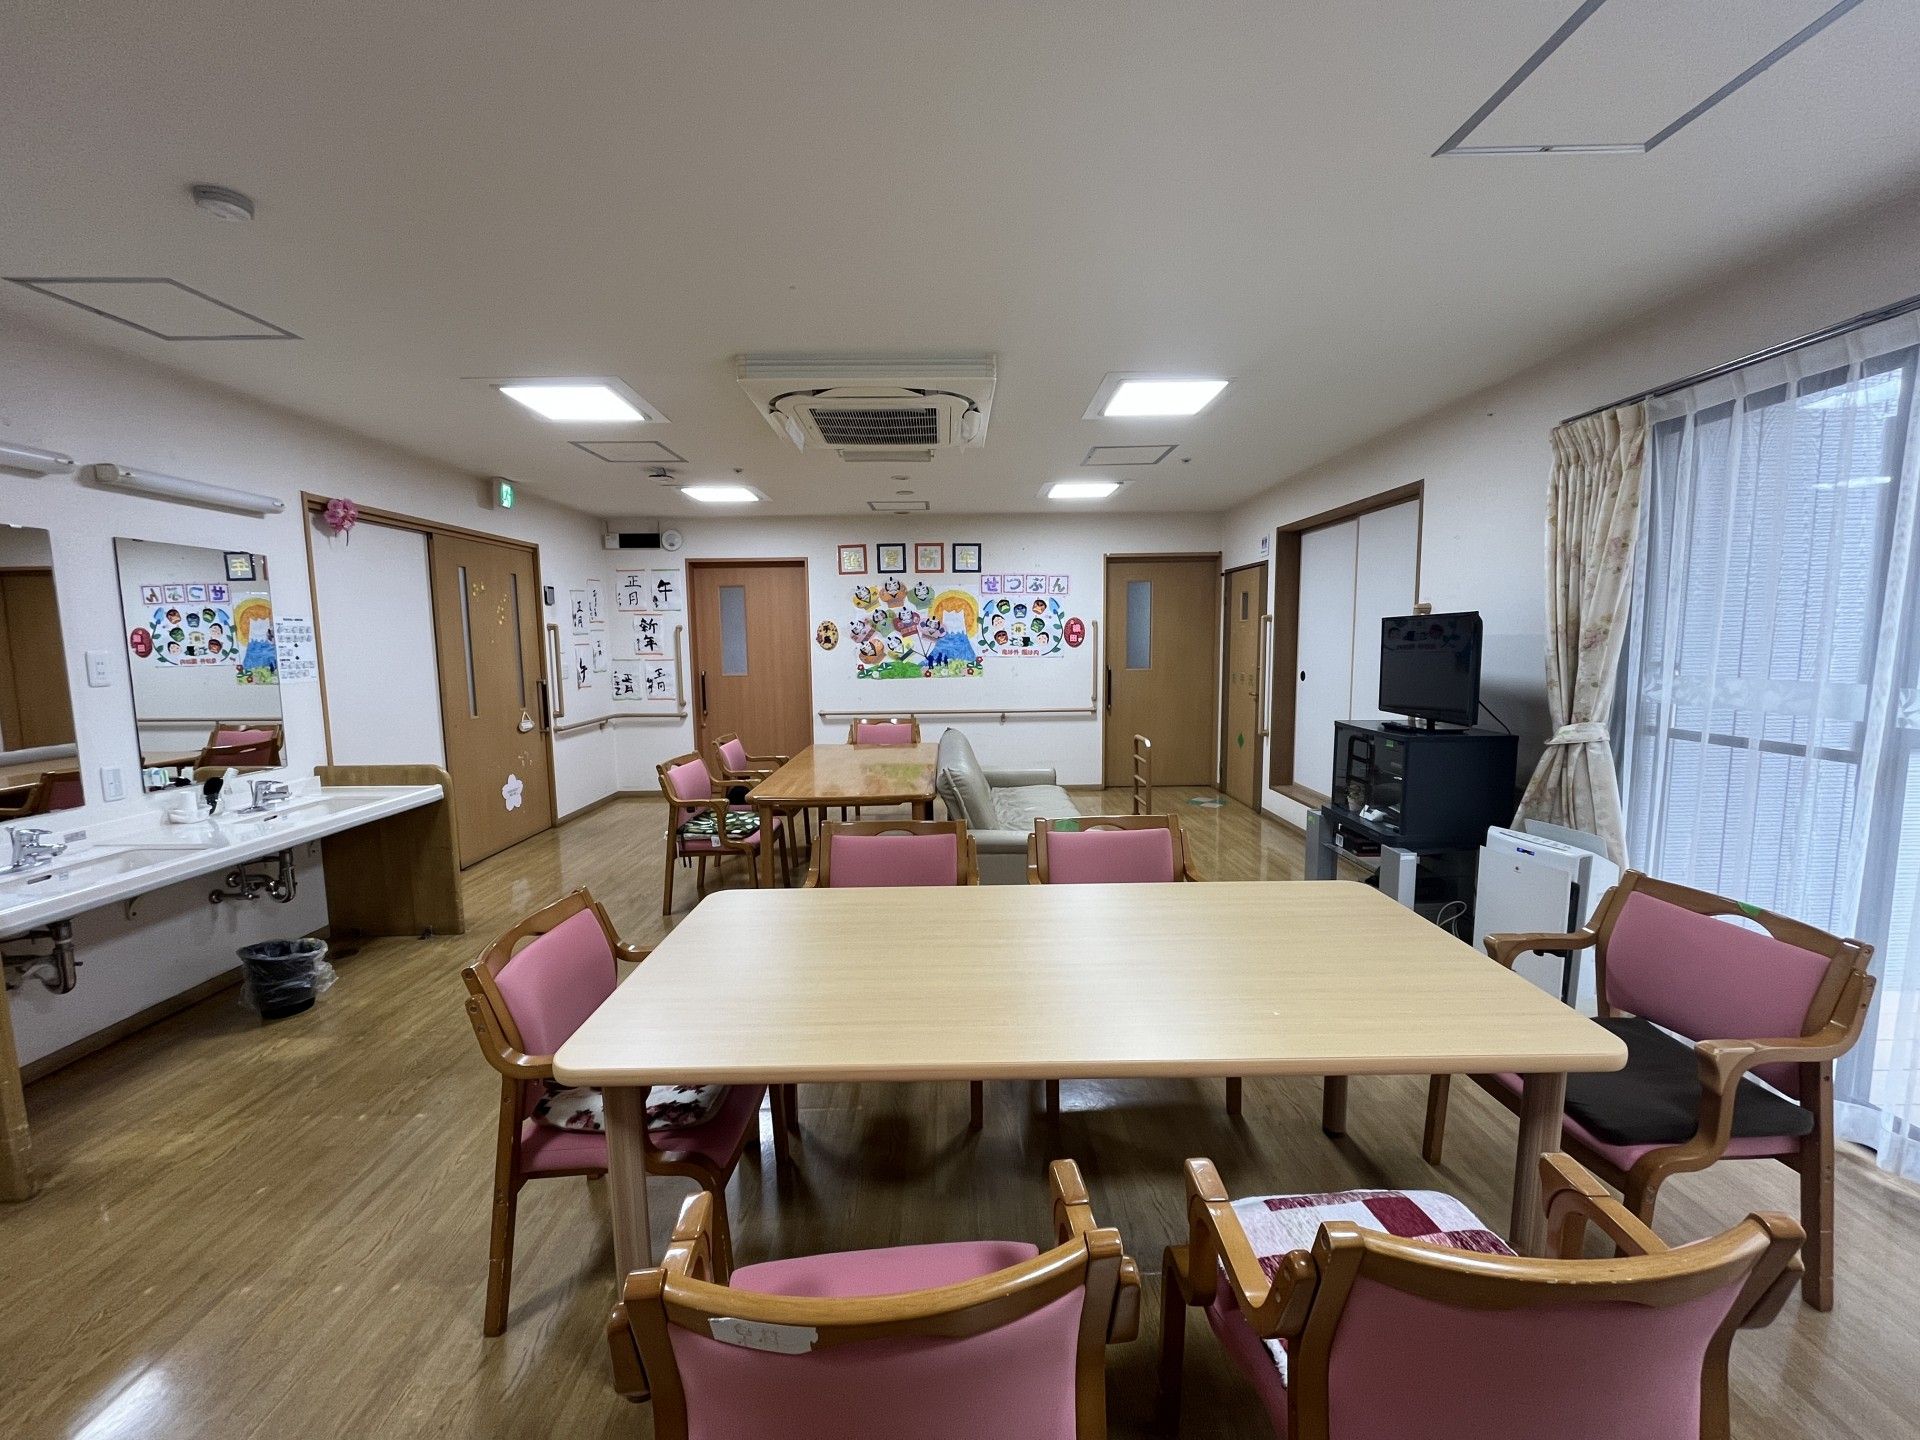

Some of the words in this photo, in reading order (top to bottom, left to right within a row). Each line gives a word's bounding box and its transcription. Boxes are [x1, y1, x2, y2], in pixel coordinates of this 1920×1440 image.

[984, 576, 1066, 593] せつぶん
[639, 618, 659, 652] 新年
